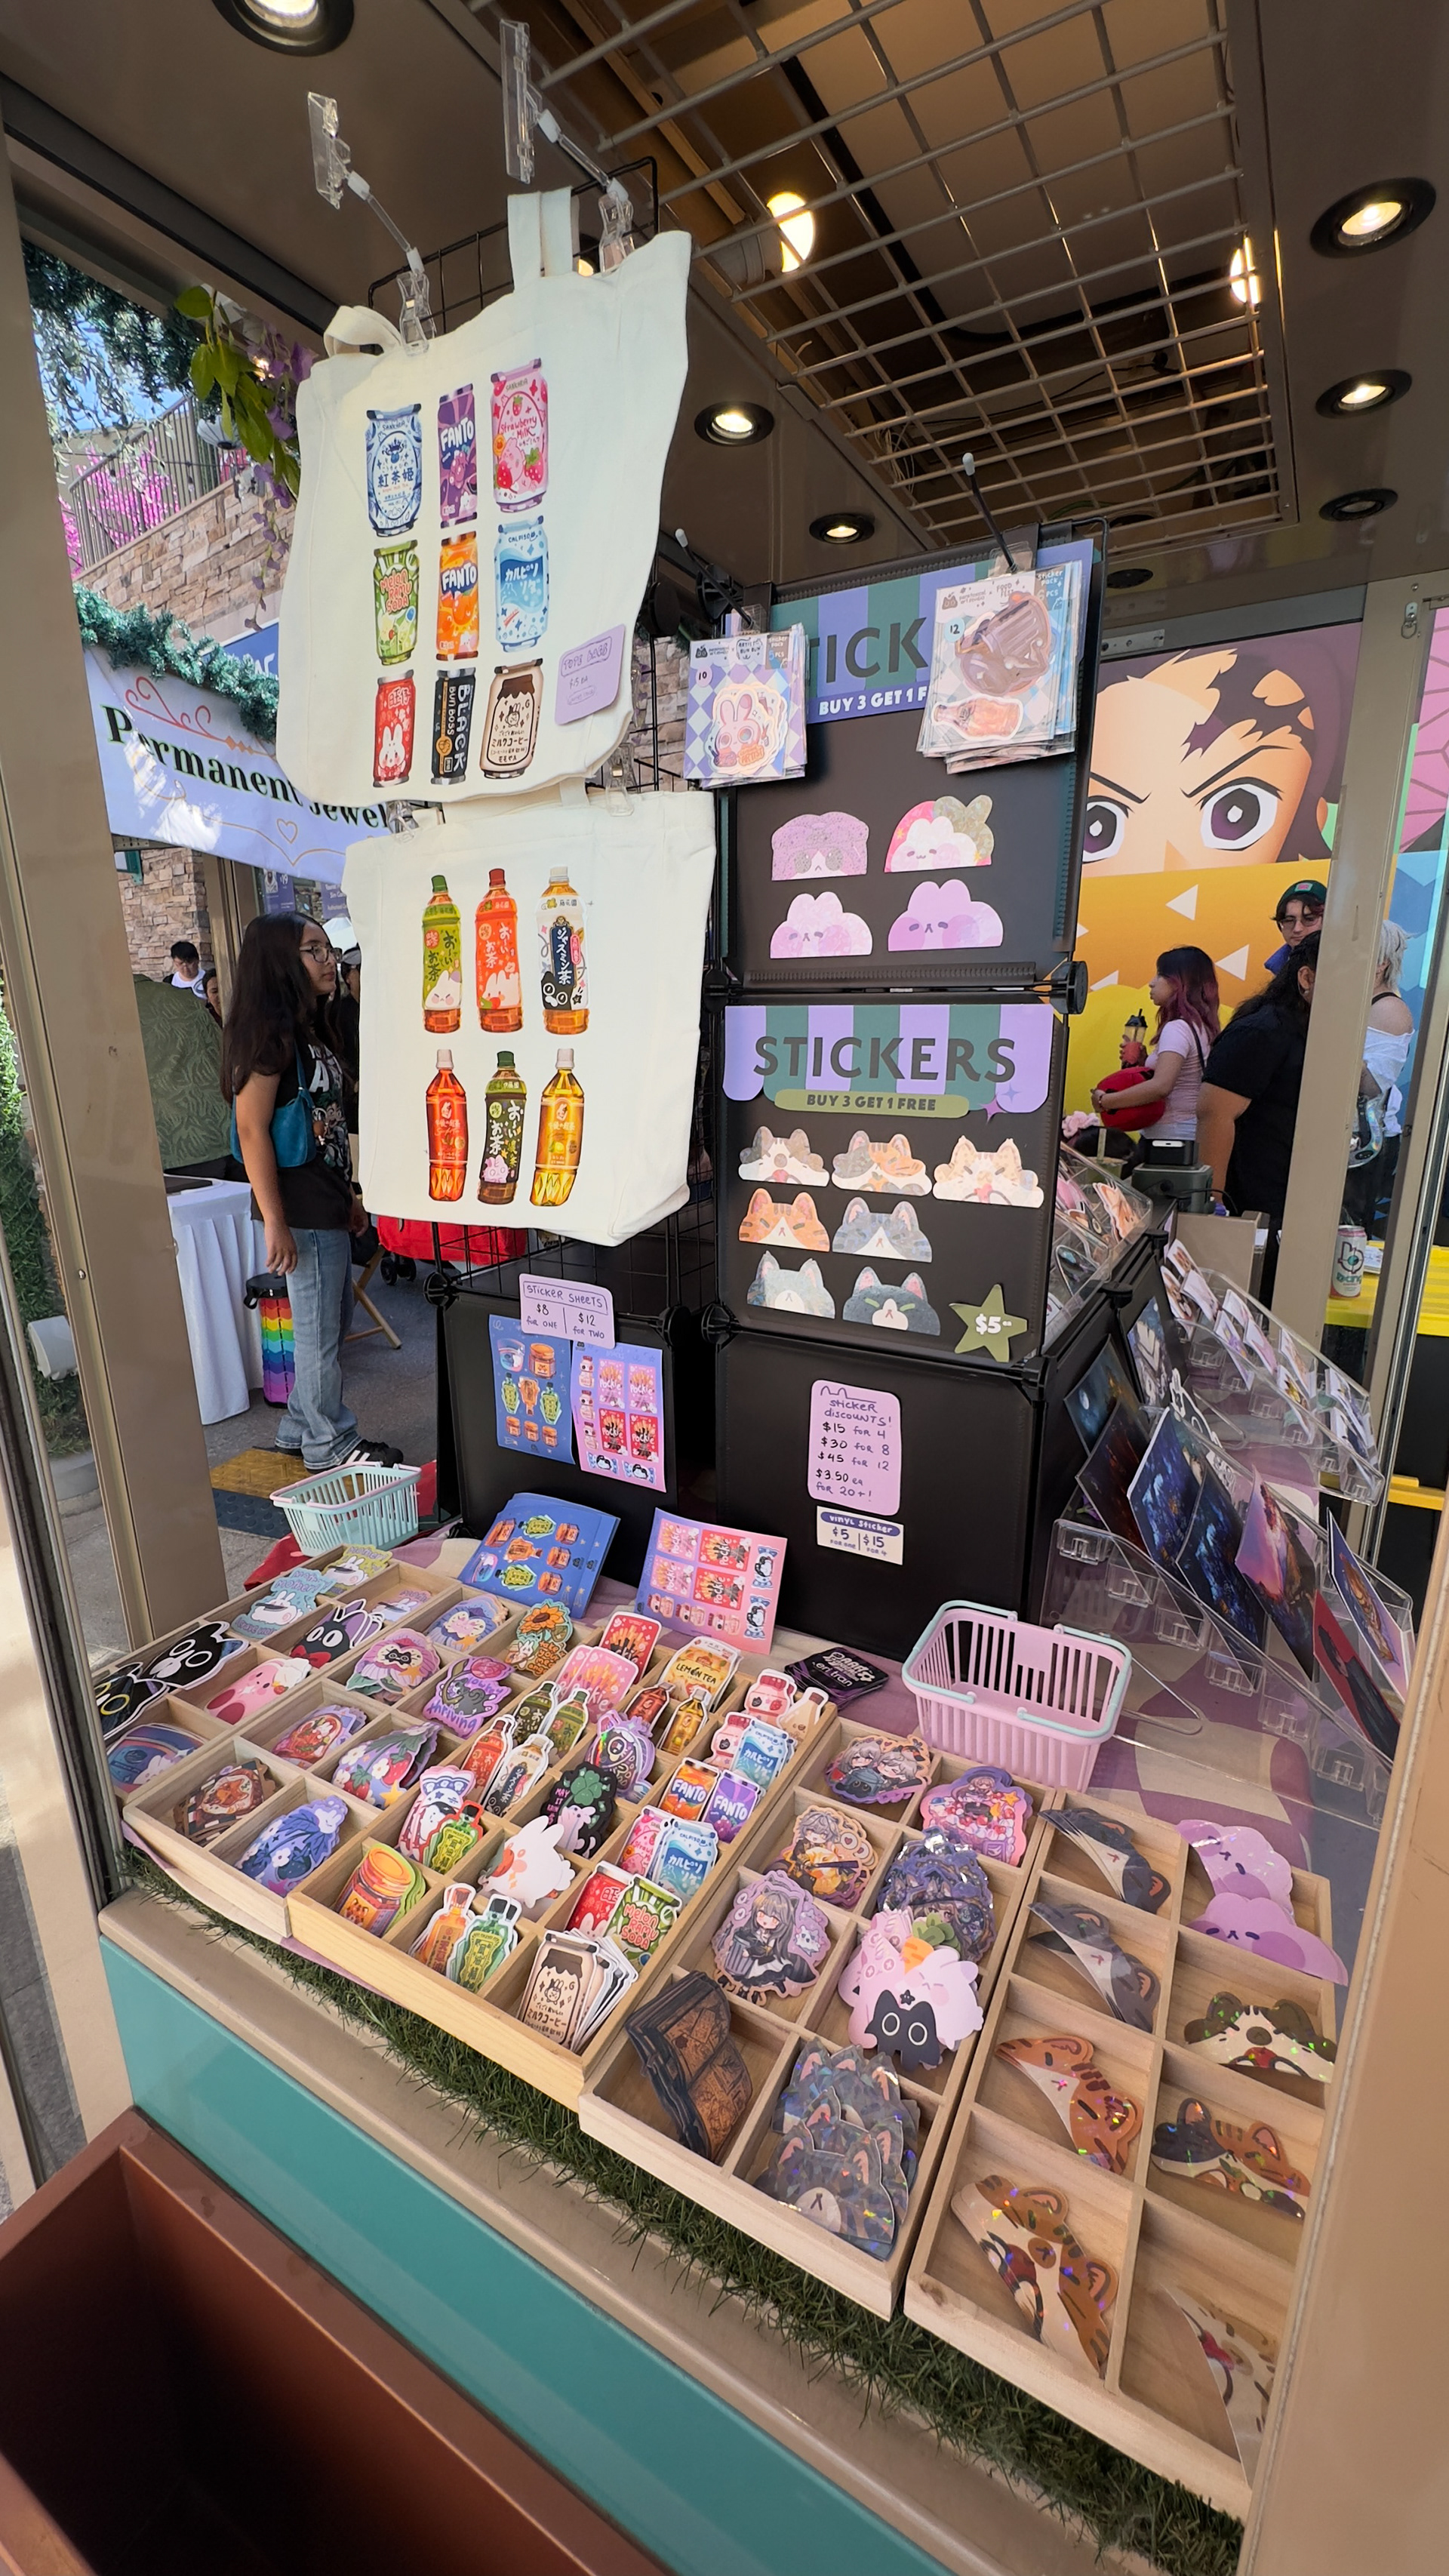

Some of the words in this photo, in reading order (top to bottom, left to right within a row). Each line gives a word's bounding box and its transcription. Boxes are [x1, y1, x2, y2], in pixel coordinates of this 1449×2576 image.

[441, 417, 474, 451] FANTO
[501, 417, 537, 433] Strawberry
[380, 568, 408, 592] Melon
[442, 563, 477, 591] FANTO
[388, 581, 412, 599] RAMU
[386, 596, 408, 613] SODA
[949, 623, 960, 635] 12
[699, 671, 707, 681] 10
[819, 696, 854, 716] BUY
[857, 694, 866, 710] 3
[871, 689, 903, 708] GET
[906, 688, 914, 703] 1
[454, 684, 470, 771] BLACK
[556, 926, 573, 986] ジャスミン茶
[753, 1036, 1017, 1084] STICKERS
[807, 1094, 838, 1106] BUY
[842, 1095, 851, 1107] 3
[854, 1096, 883, 1109] GET
[887, 1097, 894, 1109] 1
[897, 1097, 936, 1111] FREE
[537, 1303, 549, 1316] $8
[543, 1320, 557, 1329] ONE
[578, 1313, 595, 1327] $12
[975, 1313, 1001, 1335] $5
[588, 1330, 605, 1339] TWO
[823, 1421, 845, 1433] $15
[877, 1430, 885, 1439] 4
[820, 1436, 848, 1449] $30
[881, 1444, 890, 1455] 8
[817, 1451, 844, 1463] $45
[878, 1460, 889, 1471] 12
[815, 1468, 849, 1483] $3.50
[832, 1526, 849, 1540] $5
[863, 1534, 884, 1548] $15
[539, 1641, 559, 1653] take
[675, 1663, 702, 1679] LEMON
[703, 1673, 716, 1685] TEA
[426, 1700, 477, 1735] thriving
[555, 1788, 570, 1798] MAY
[672, 1779, 707, 1802] FANTO
[713, 1796, 748, 1820] FANTO
[623, 1904, 658, 1927] Melon
[620, 1926, 650, 1950] SODA
[629, 1919, 659, 1940] RAMU
